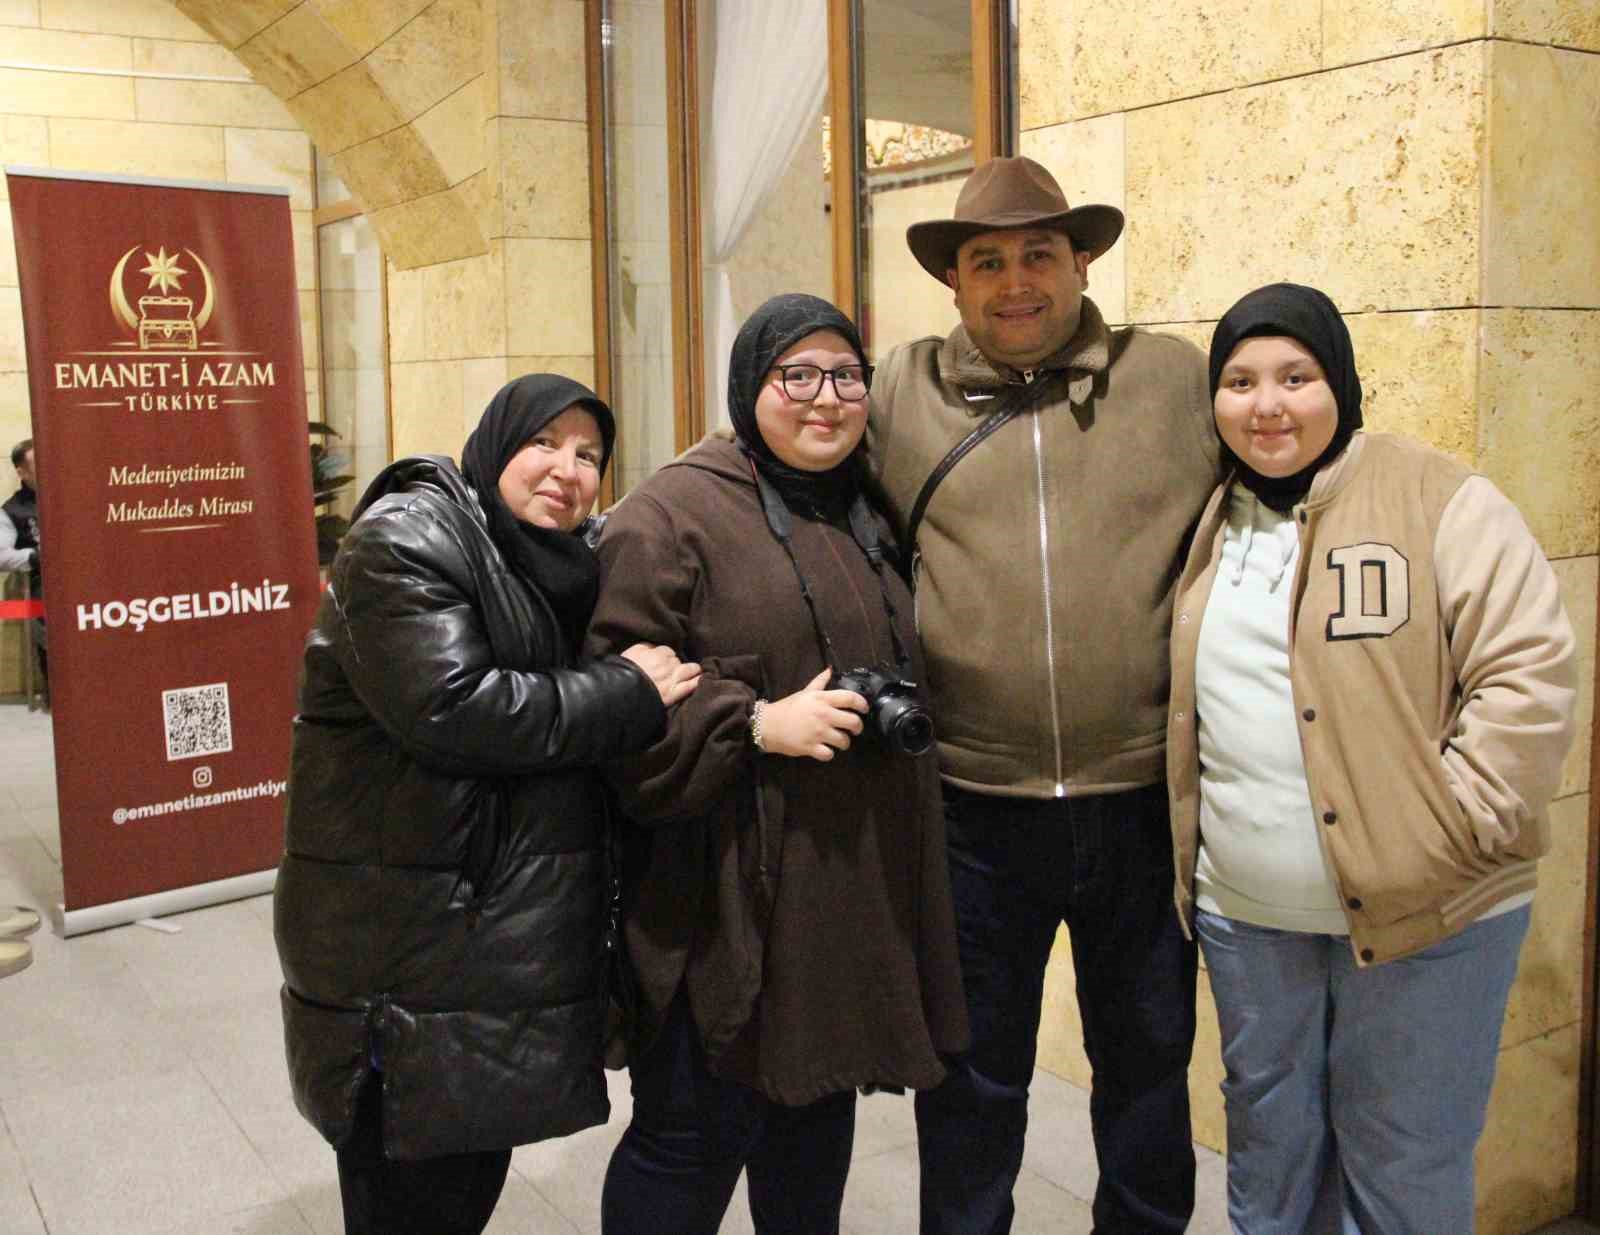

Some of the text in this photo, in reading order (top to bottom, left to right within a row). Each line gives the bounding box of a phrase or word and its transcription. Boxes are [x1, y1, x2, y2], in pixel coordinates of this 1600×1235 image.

[55, 358, 275, 389] EMANET-İ AZAM
[125, 392, 218, 412] TÜRKİYE
[108, 462, 245, 488] Medeniyetimizin
[106, 497, 253, 523] Mukaddes Mirası
[76, 578, 291, 632] HOŞGELDİNİZ
[1325, 541, 1410, 642] D
